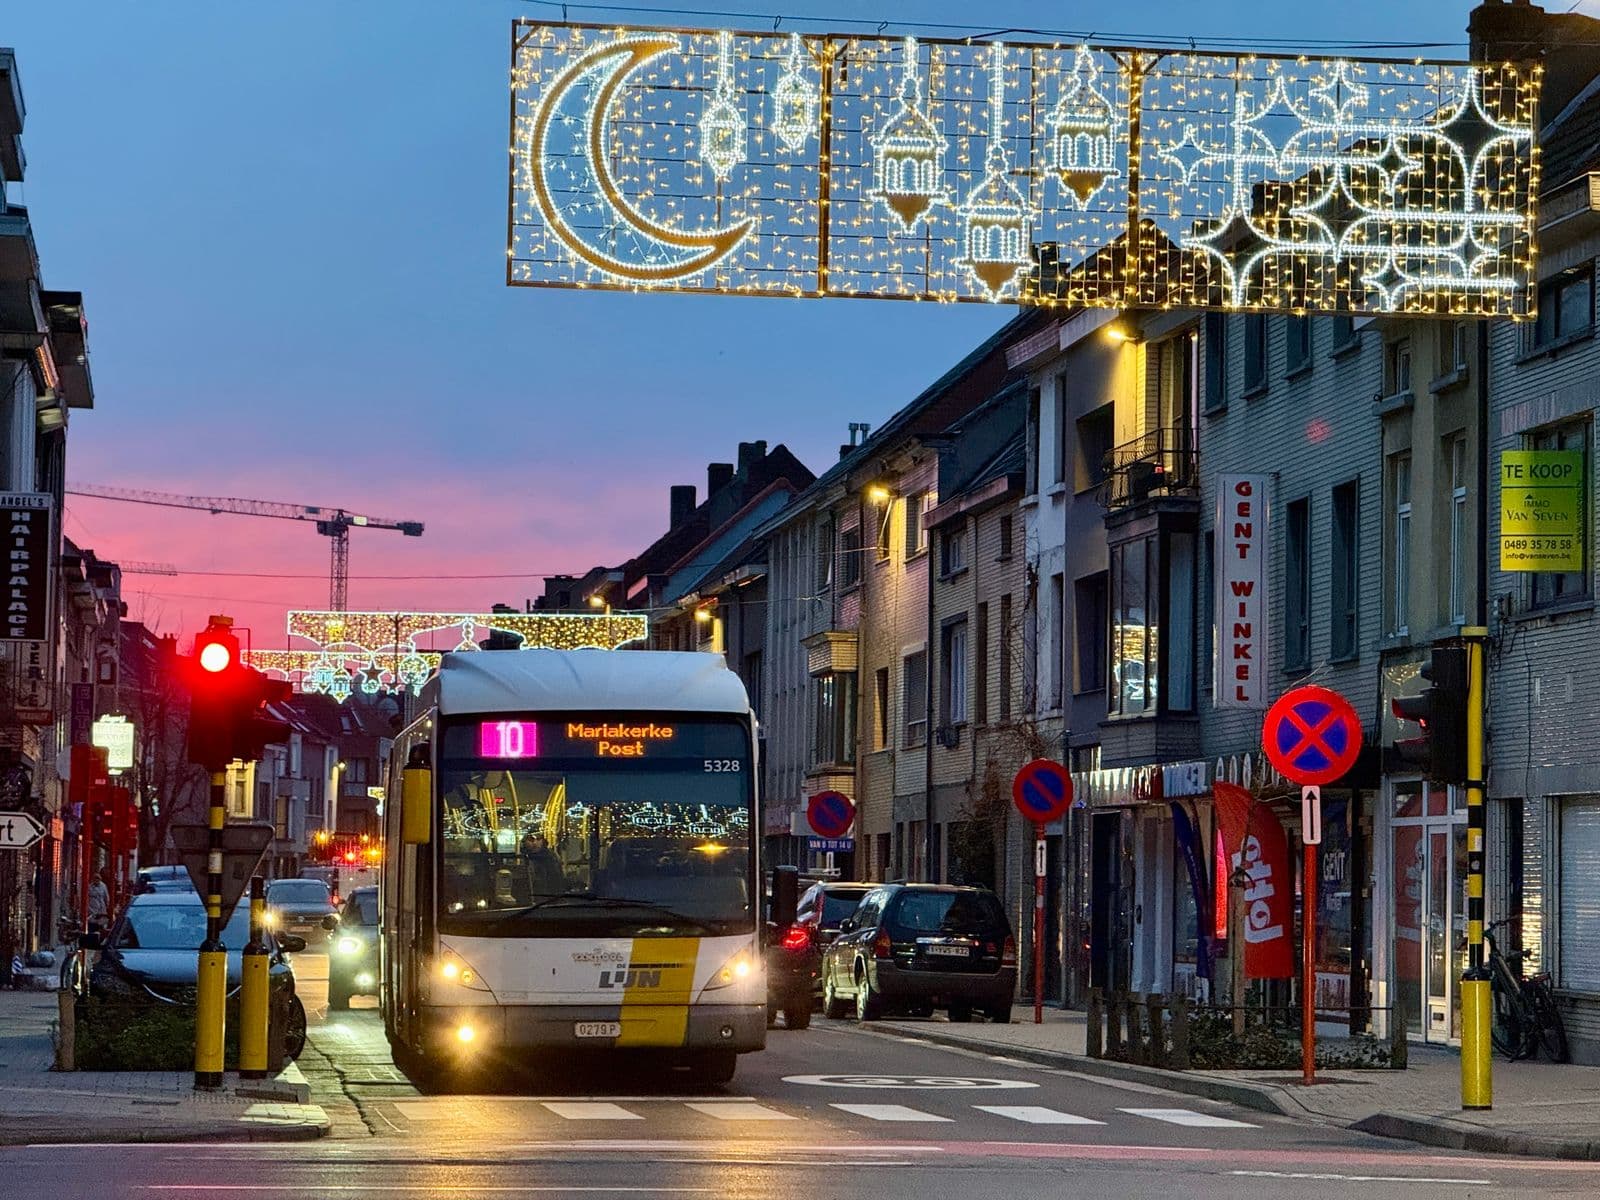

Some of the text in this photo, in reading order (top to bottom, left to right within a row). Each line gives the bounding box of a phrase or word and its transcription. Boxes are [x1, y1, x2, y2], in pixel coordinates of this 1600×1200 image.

[1504, 464, 1572, 479] TE KOOP
[1533, 509, 1569, 521] SEVEN
[1504, 540, 1572, 550] 0489 35 78 58
[8, 511, 30, 637] HAIRPALACE
[1230, 480, 1254, 702] GENT WINKEL
[567, 723, 673, 738] Mariakerke
[496, 721, 525, 758] 10
[599, 741, 644, 756] Post
[704, 760, 740, 772] 5328
[580, 1024, 616, 1035] 0279 P
